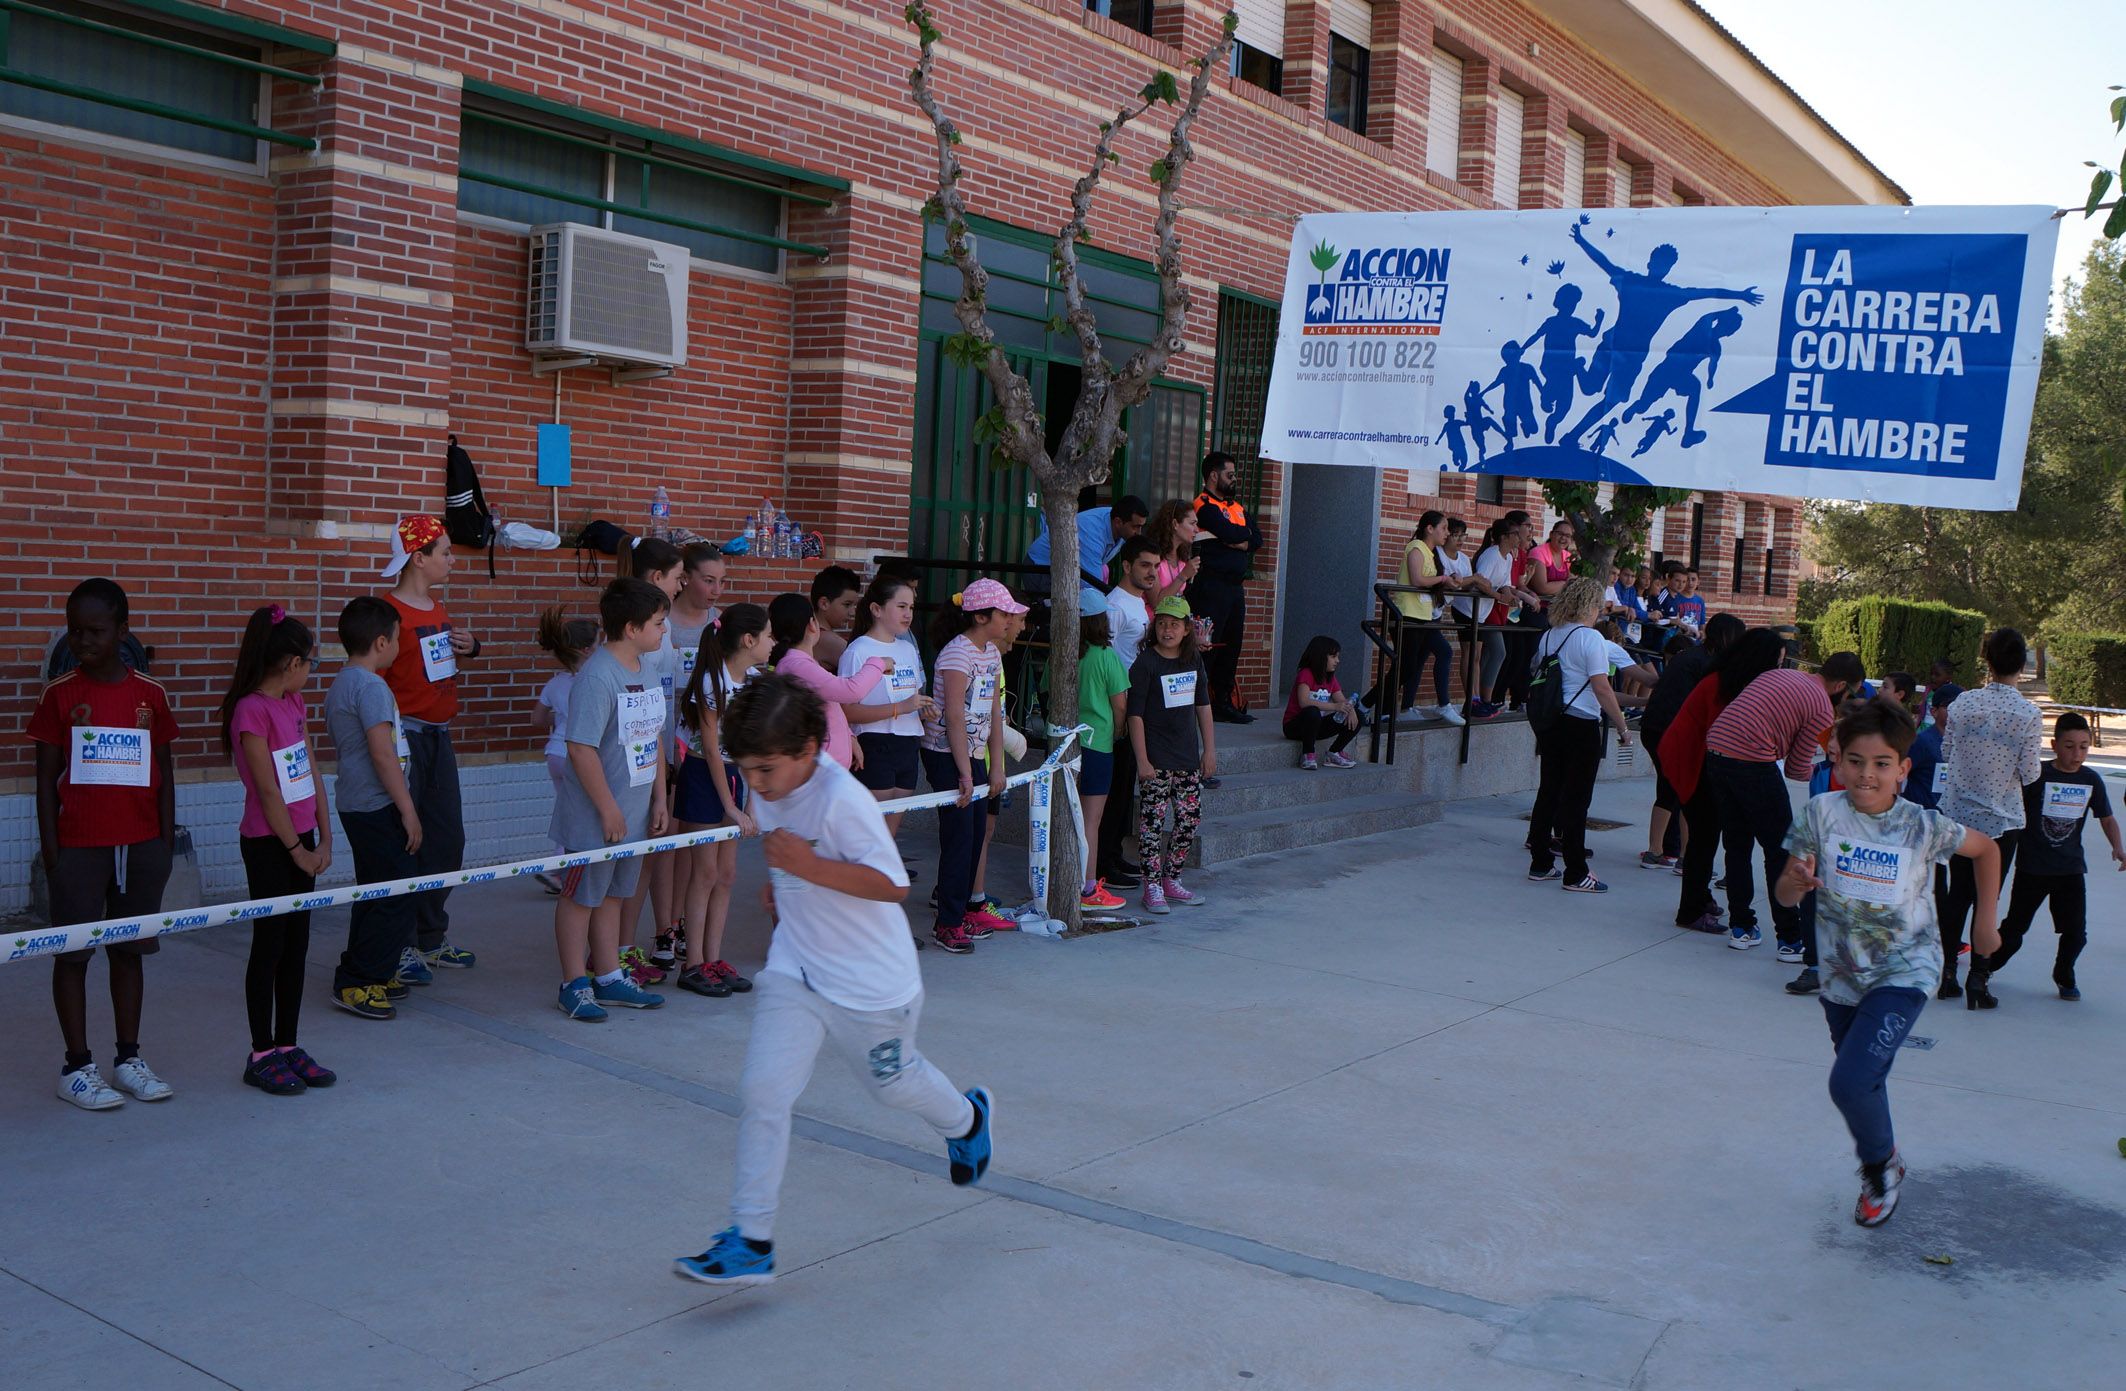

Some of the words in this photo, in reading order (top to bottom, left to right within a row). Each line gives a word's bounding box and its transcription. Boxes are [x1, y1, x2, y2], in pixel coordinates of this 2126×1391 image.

[1340, 248, 1451, 282] ACCION
[1800, 249, 1853, 286] LA
[1371, 277, 1403, 287] CONTRA
[1404, 277, 1414, 287] EL
[1336, 286, 1445, 321] HAMBRE
[1795, 288, 2001, 334] CARRERA
[1336, 326, 1433, 335] INTERNATIONAL
[1299, 341, 1339, 368] 900
[1347, 341, 1387, 368] 100
[1393, 341, 1437, 369] 822
[1790, 330, 1964, 376] CONTRA
[1296, 371, 1435, 386] www.accioncontraelhambre.org
[1785, 372, 1834, 412] EL
[1288, 429, 1429, 446] www.carreracontraelhambre.org
[1780, 414, 1969, 464] HAMBRE
[97, 733, 141, 747] ACCION
[97, 746, 141, 761] HAMBRE
[1852, 846, 1899, 866] ACCION
[468, 871, 496, 883] ACCION
[518, 864, 544, 875] ACCION
[1851, 860, 1897, 880] HAMBRE
[360, 887, 390, 900] ACCION
[415, 879, 444, 892] ACCION
[302, 896, 333, 909] ACCION
[238, 905, 273, 919] ACCION
[172, 914, 209, 928] ACCION
[102, 923, 141, 939] ACCION
[27, 933, 68, 950] ACCION
